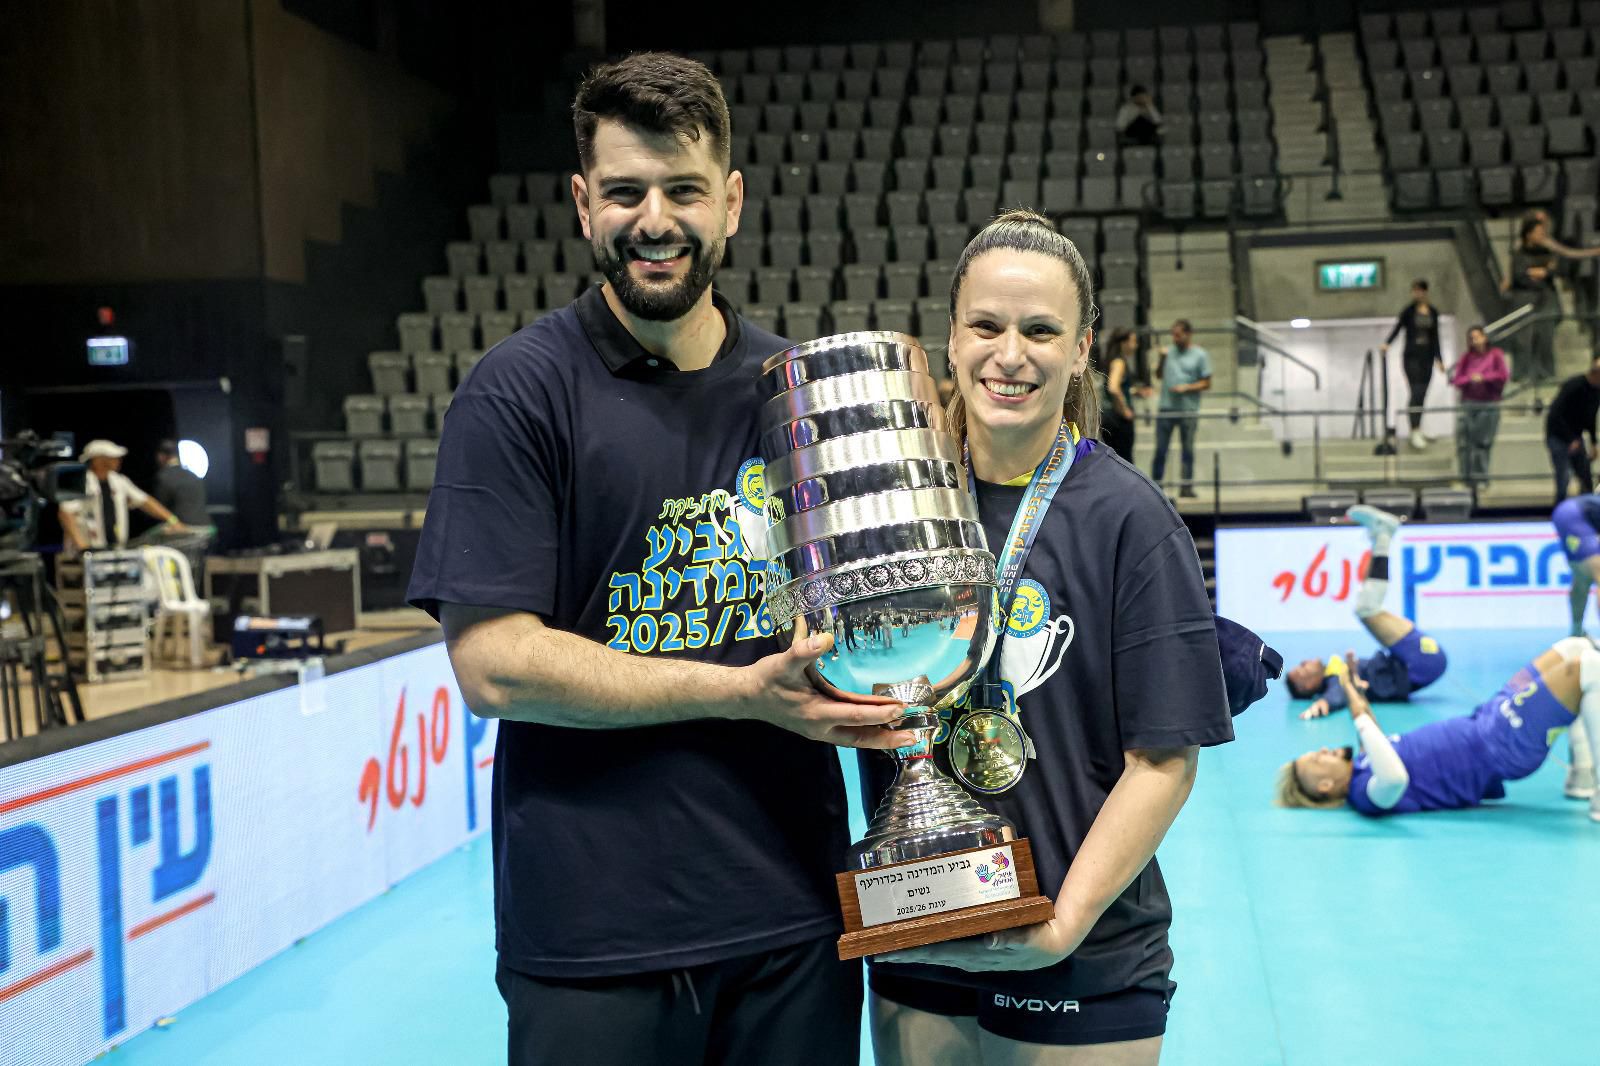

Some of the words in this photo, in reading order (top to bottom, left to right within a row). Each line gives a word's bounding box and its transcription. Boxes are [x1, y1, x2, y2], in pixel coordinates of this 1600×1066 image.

[658, 494, 727, 526] מחזיקת
[643, 516, 748, 572] גביע
[608, 558, 767, 612] המדינה
[606, 602, 774, 653] 2025/26
[907, 864, 945, 880] המדינה
[948, 859, 971, 873] גביע
[859, 872, 904, 891] בכדורעף
[907, 885, 931, 898] נשים
[96, 764, 213, 1039] עין
[928, 899, 947, 910] עונת
[994, 993, 1080, 1013] GIVOVA
